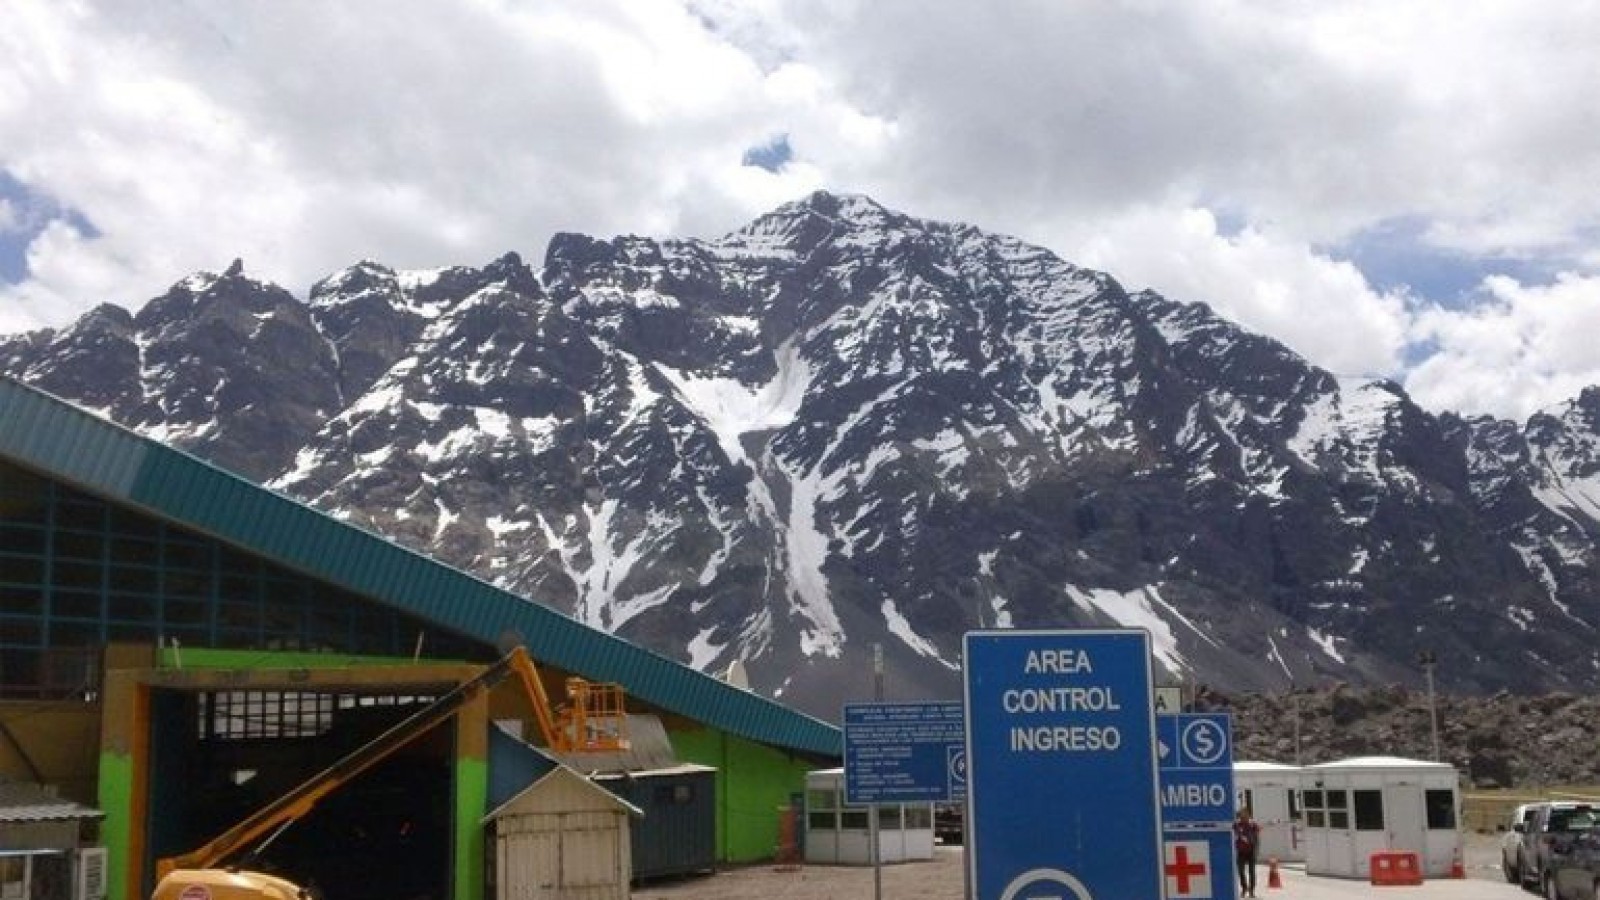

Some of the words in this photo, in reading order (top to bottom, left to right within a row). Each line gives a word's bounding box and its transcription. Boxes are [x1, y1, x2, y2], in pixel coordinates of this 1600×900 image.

[1024, 650, 1092, 674] AREA
[1003, 687, 1121, 713] CONTROL
[1011, 727, 1121, 751] INGRESO
